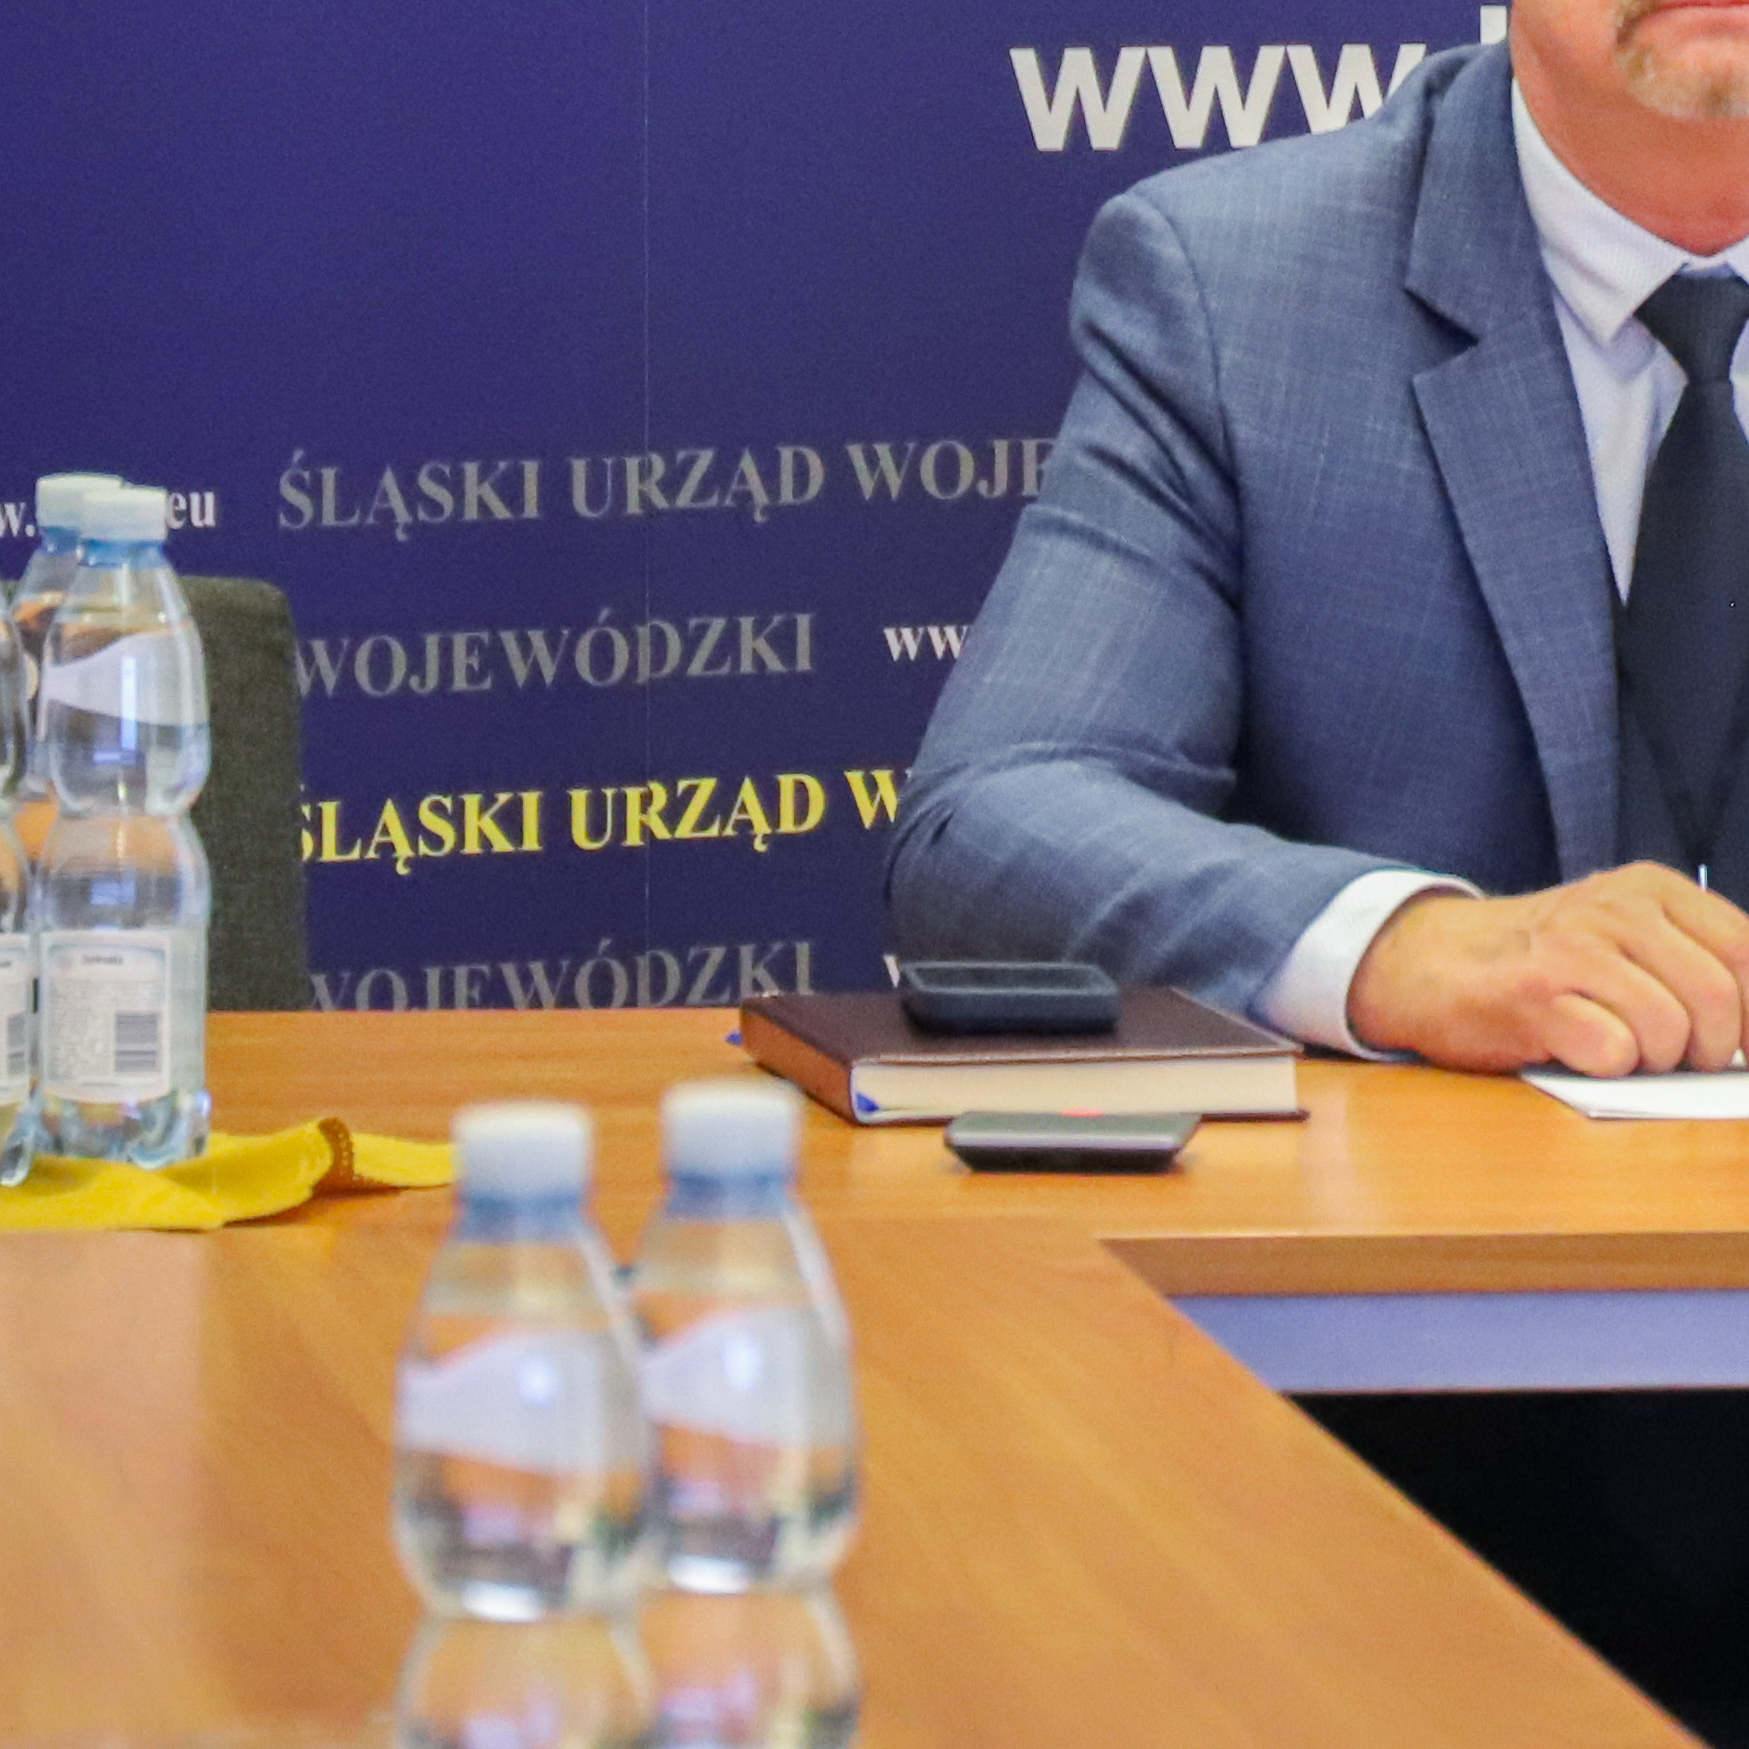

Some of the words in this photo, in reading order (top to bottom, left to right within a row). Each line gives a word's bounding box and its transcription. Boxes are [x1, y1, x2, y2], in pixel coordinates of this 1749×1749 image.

[279, 449, 540, 541] ŚLĄSKI
[570, 446, 824, 523] URZĄD
[298, 607, 813, 698] WOJEWÓDZKI
[567, 774, 826, 852] URZĄD
